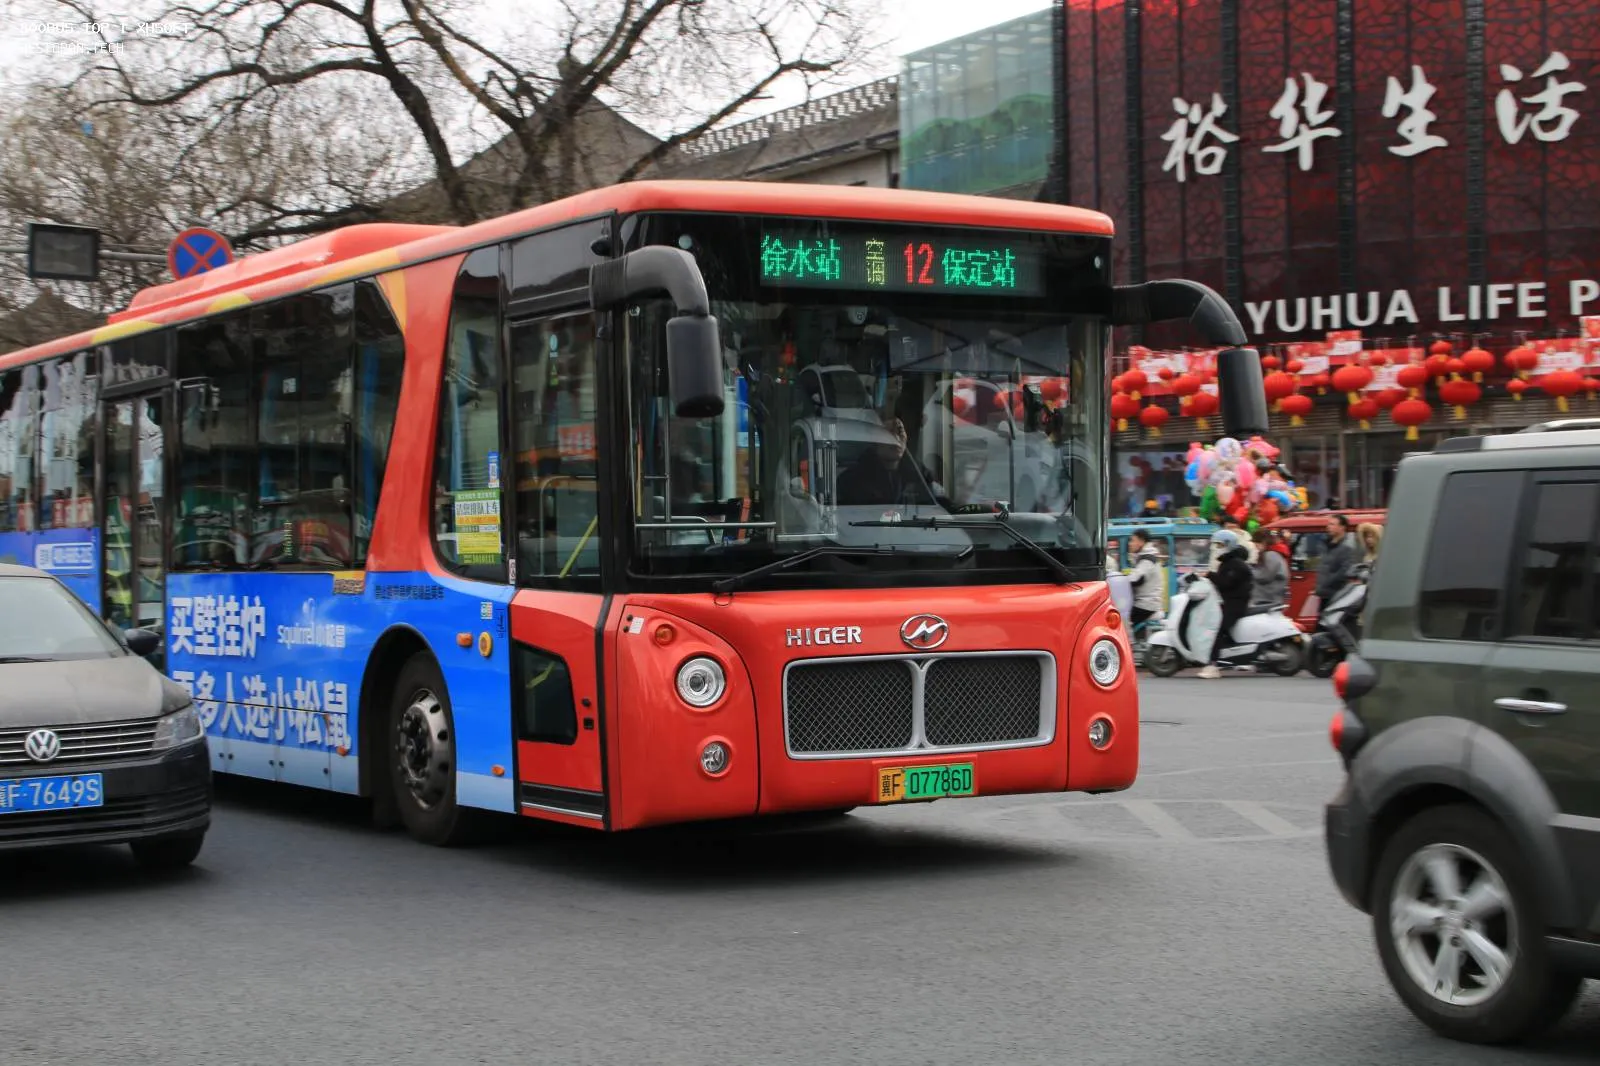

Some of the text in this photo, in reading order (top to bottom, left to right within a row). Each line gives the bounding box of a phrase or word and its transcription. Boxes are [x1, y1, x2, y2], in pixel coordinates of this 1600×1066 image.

[1160, 51, 1588, 182] 裕华生活
[760, 235, 1016, 288] 徐水站 空调 12 保定站
[1244, 288, 1420, 335] YUHUA
[1437, 281, 1548, 323] LIFE
[171, 593, 267, 658] 买壁挂炉
[785, 625, 862, 647] HIGER
